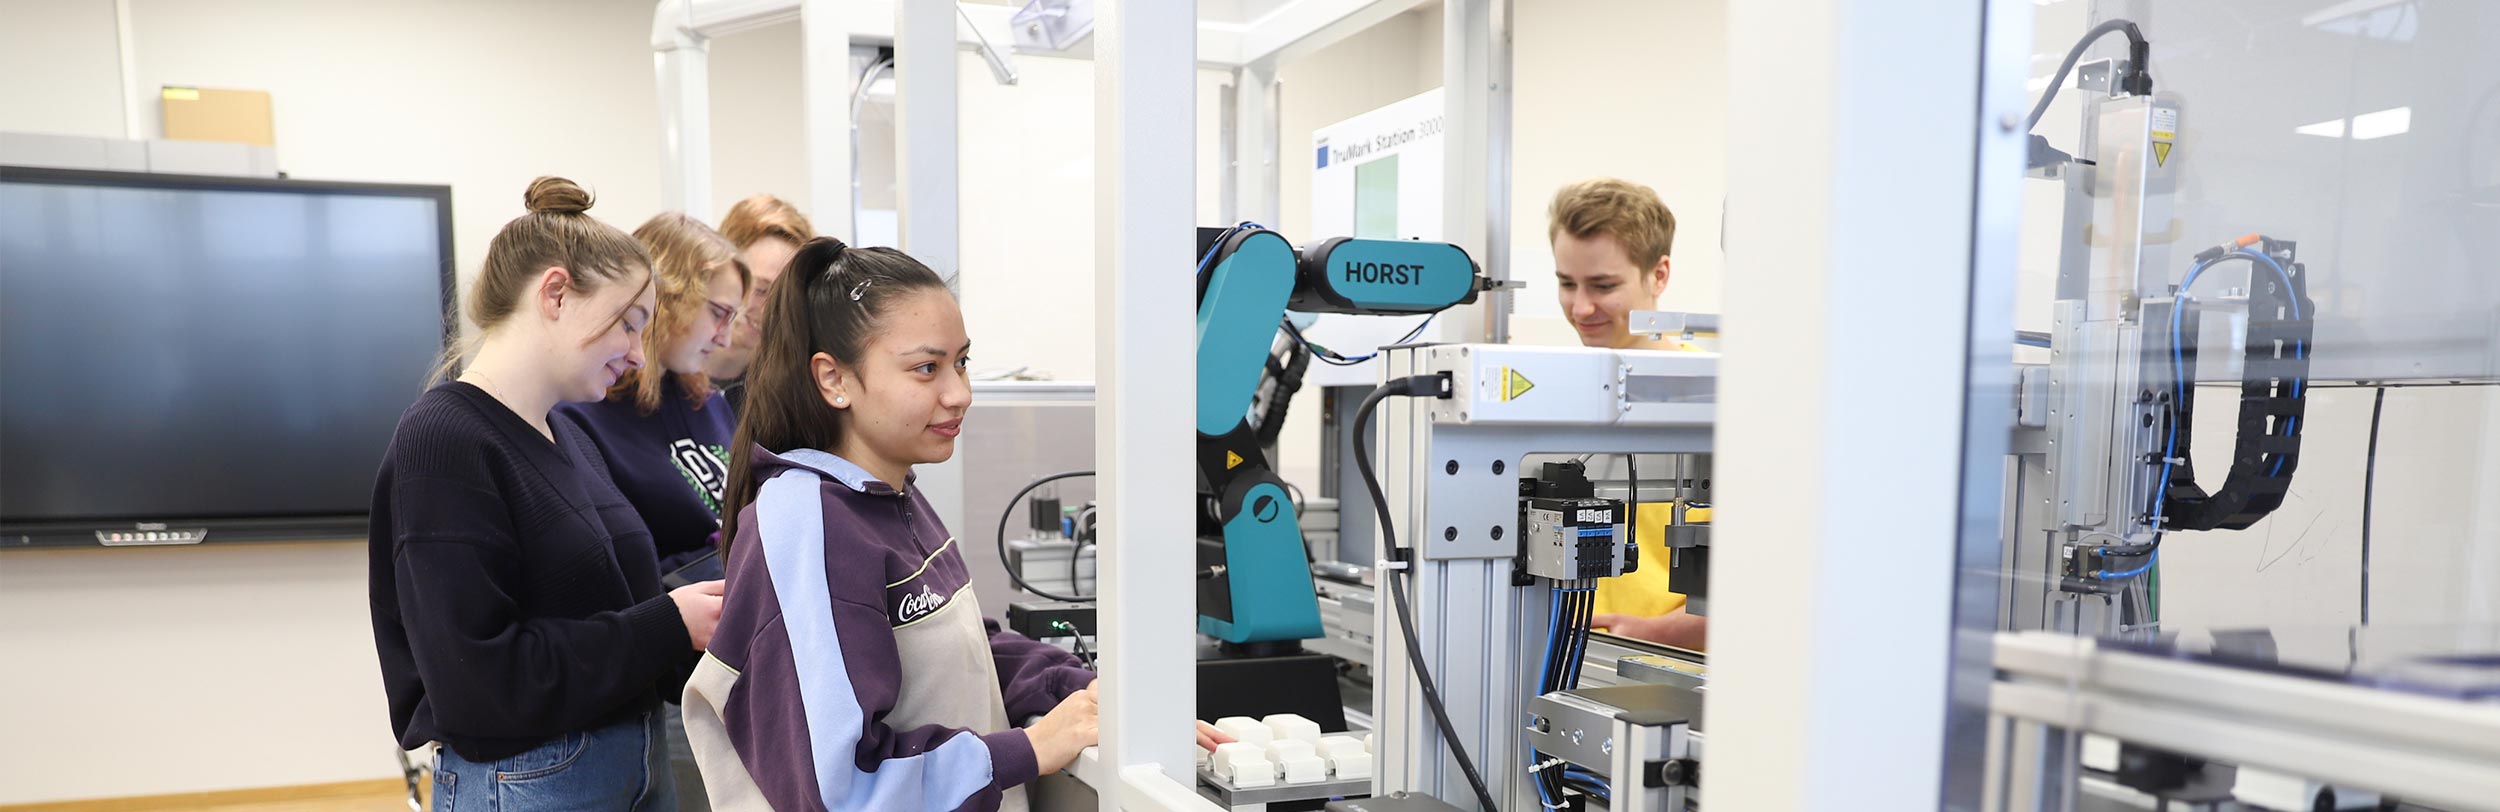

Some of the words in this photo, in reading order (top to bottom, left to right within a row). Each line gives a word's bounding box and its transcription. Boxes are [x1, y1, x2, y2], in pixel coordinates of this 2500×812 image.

[1333, 139, 1371, 163] TruMark
[1376, 127, 1415, 151] Station
[1345, 261, 1425, 285] HORST
